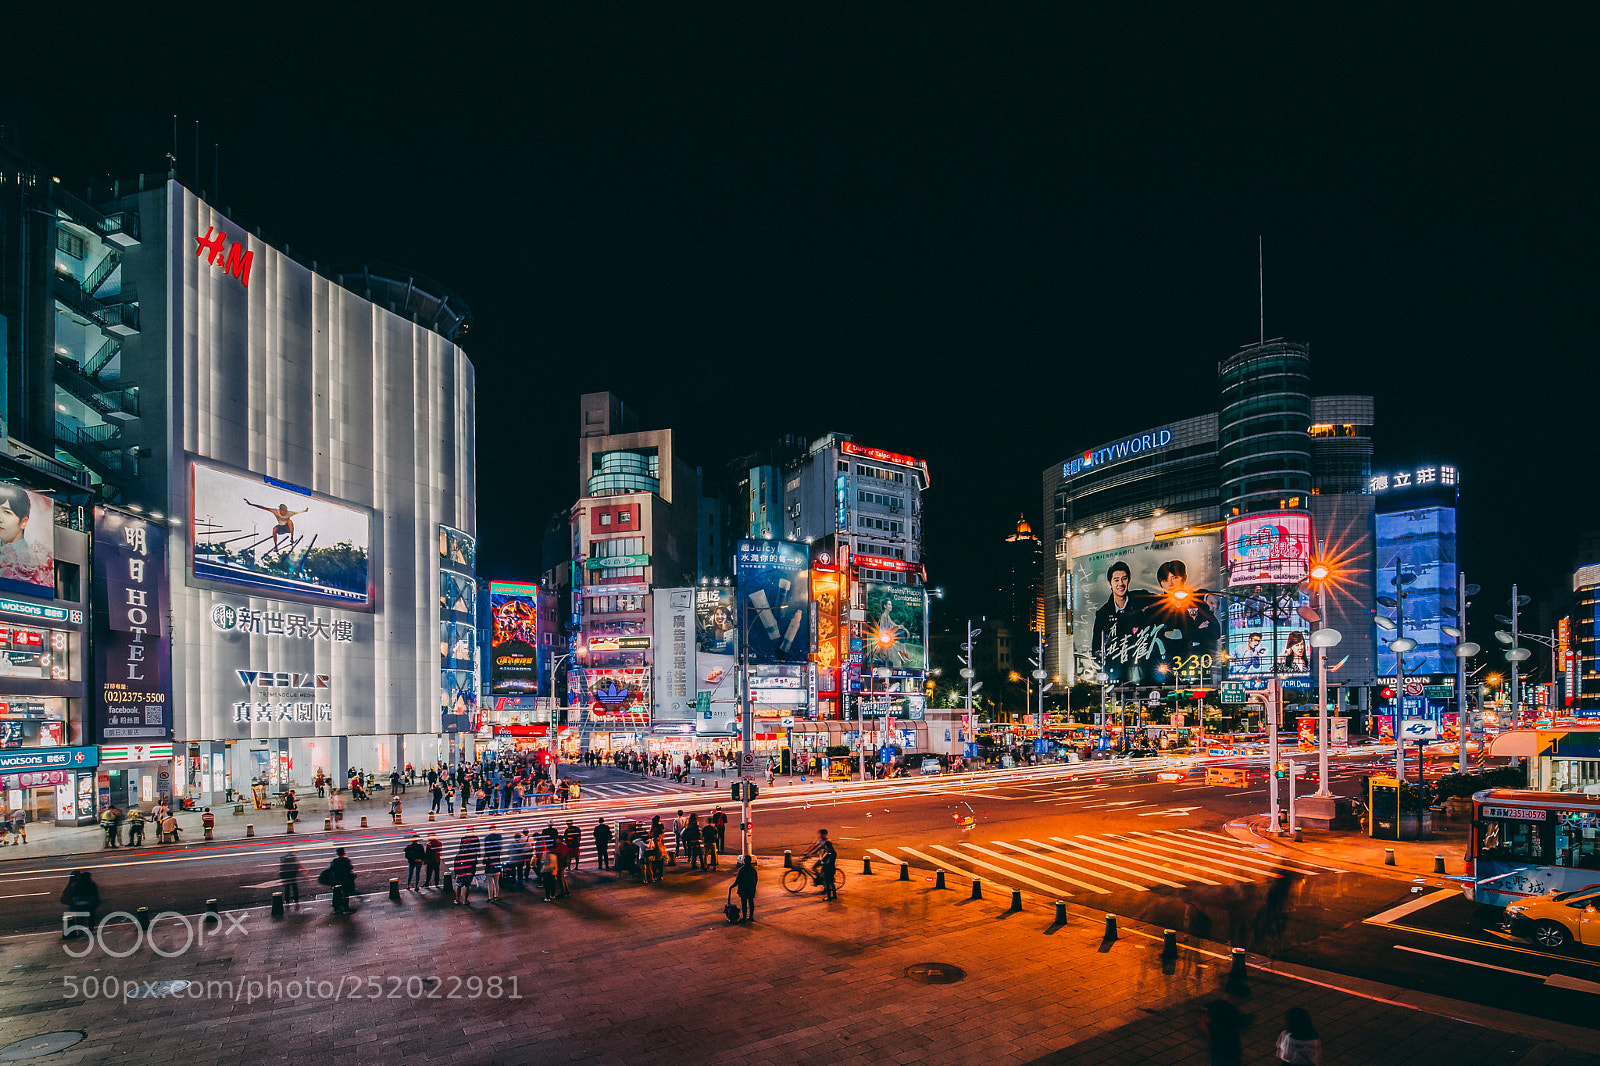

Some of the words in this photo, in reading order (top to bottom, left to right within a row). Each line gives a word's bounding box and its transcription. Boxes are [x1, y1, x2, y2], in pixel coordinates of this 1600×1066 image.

[195, 226, 254, 287] H&M
[264, 475, 312, 497] Panasonic
[1370, 467, 1436, 491] 德立莊
[124, 526, 148, 583] 明日
[1, 602, 41, 615] watsons
[125, 587, 148, 681] HOTEL
[238, 606, 353, 642] 新世界大樓
[1172, 653, 1213, 671] 3/30
[1377, 677, 1430, 685] MIDOWN
[104, 690, 165, 703] (02)2375-5500
[232, 701, 333, 723] 真善美劇院
[1548, 738, 1558, 753] 1
[1, 756, 43, 766] watsons
[1509, 808, 1546, 820] 2351-0578
